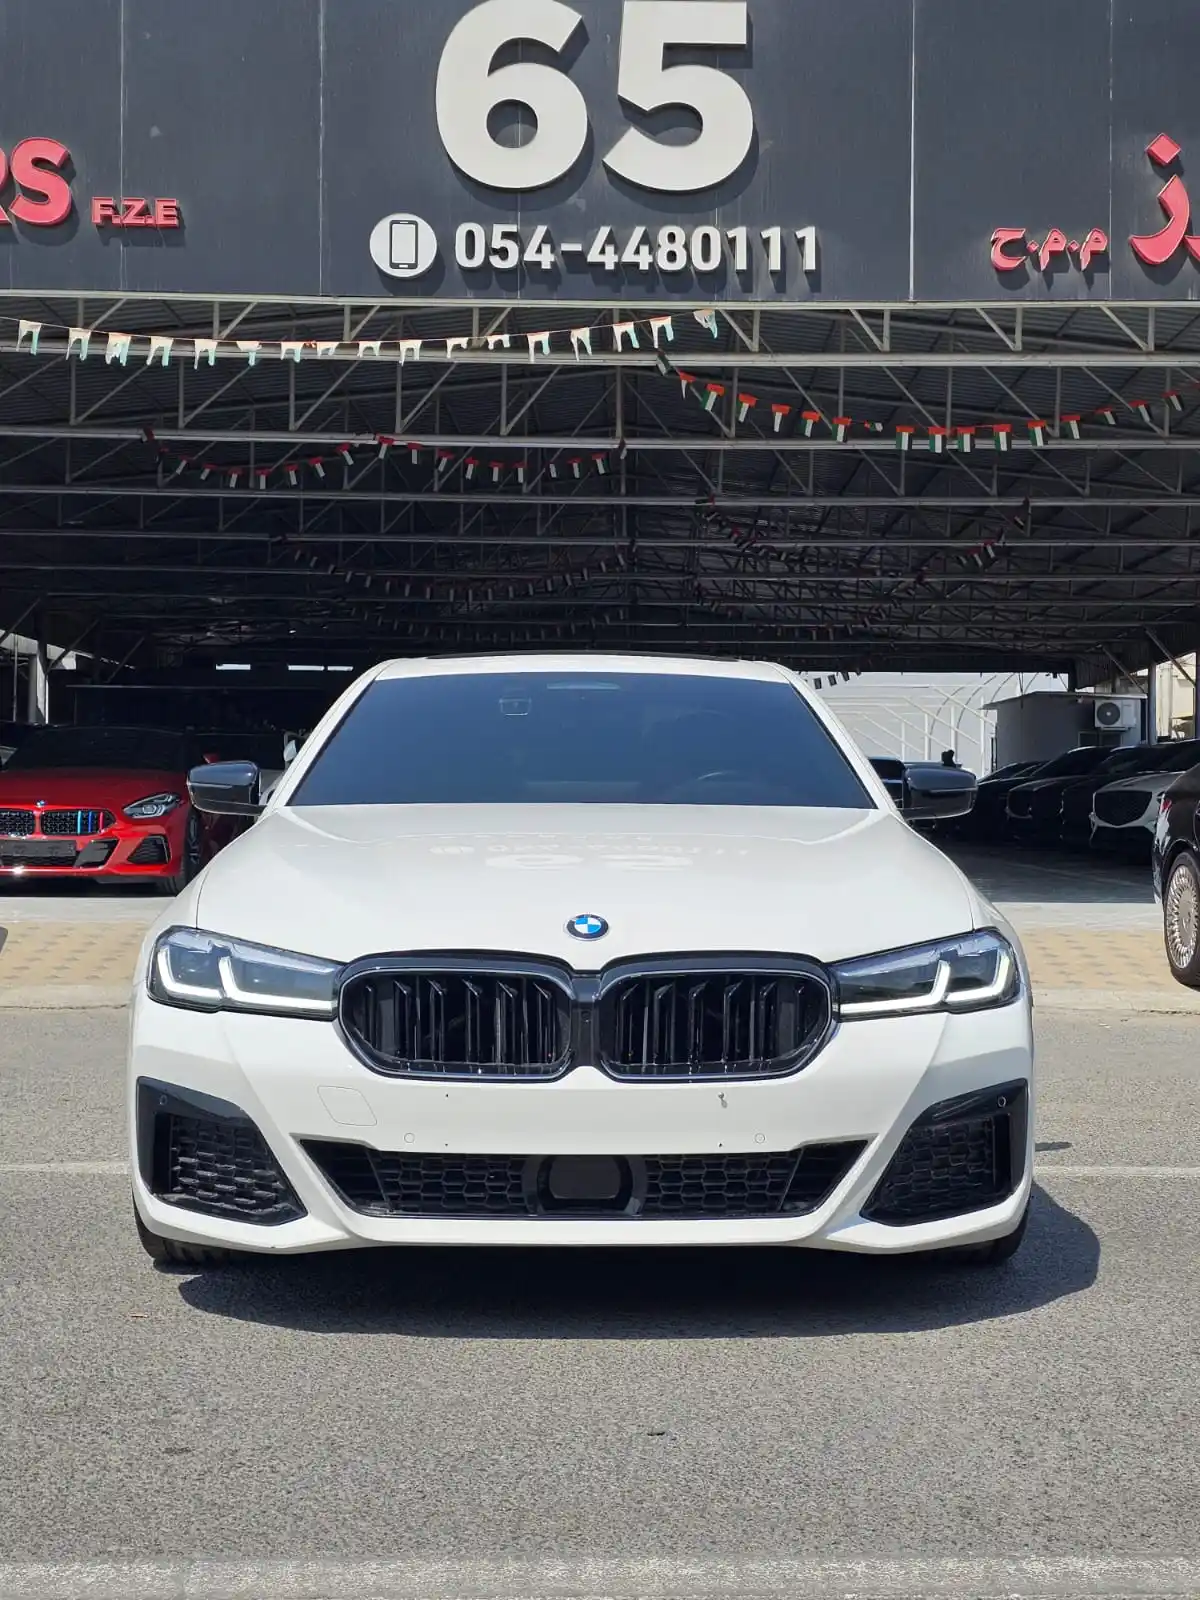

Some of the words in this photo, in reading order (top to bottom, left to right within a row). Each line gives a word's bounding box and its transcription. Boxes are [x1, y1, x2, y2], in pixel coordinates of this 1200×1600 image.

[436, 0, 754, 192] 65
[0, 137, 73, 227] S
[91, 197, 180, 228] F.Z.E
[1128, 132, 1200, 264] ز
[455, 222, 818, 272] 054-4480111
